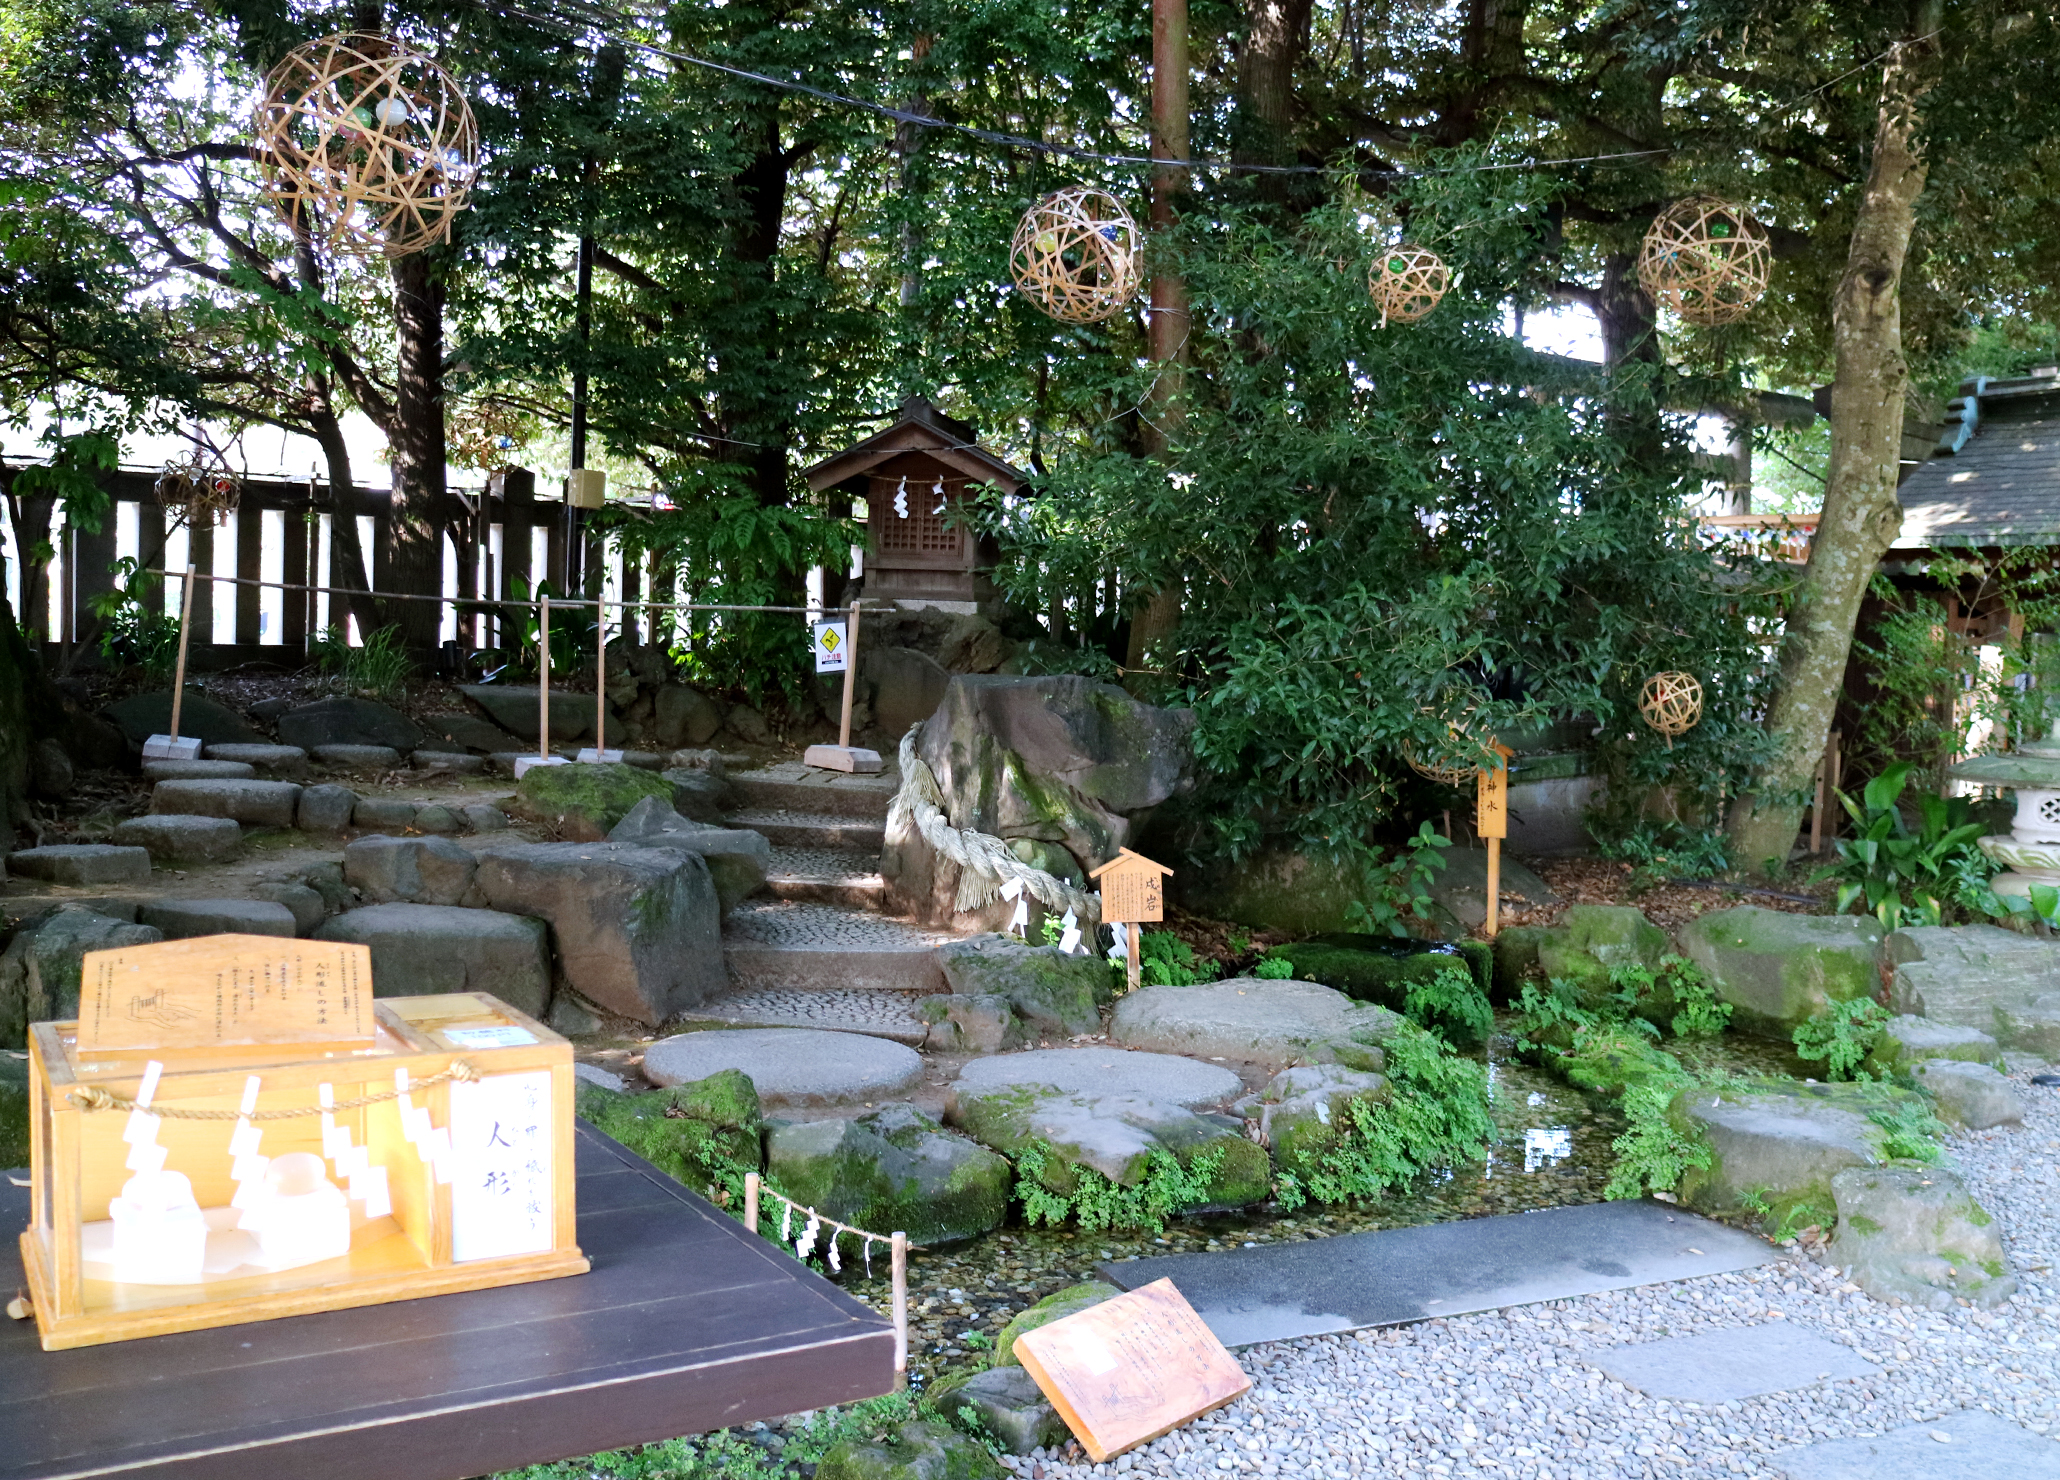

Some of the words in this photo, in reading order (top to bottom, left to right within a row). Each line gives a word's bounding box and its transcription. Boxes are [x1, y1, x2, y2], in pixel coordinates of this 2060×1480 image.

[315, 962, 328, 1025] 人形流しの方法
[482, 1120, 511, 1196] 人形
